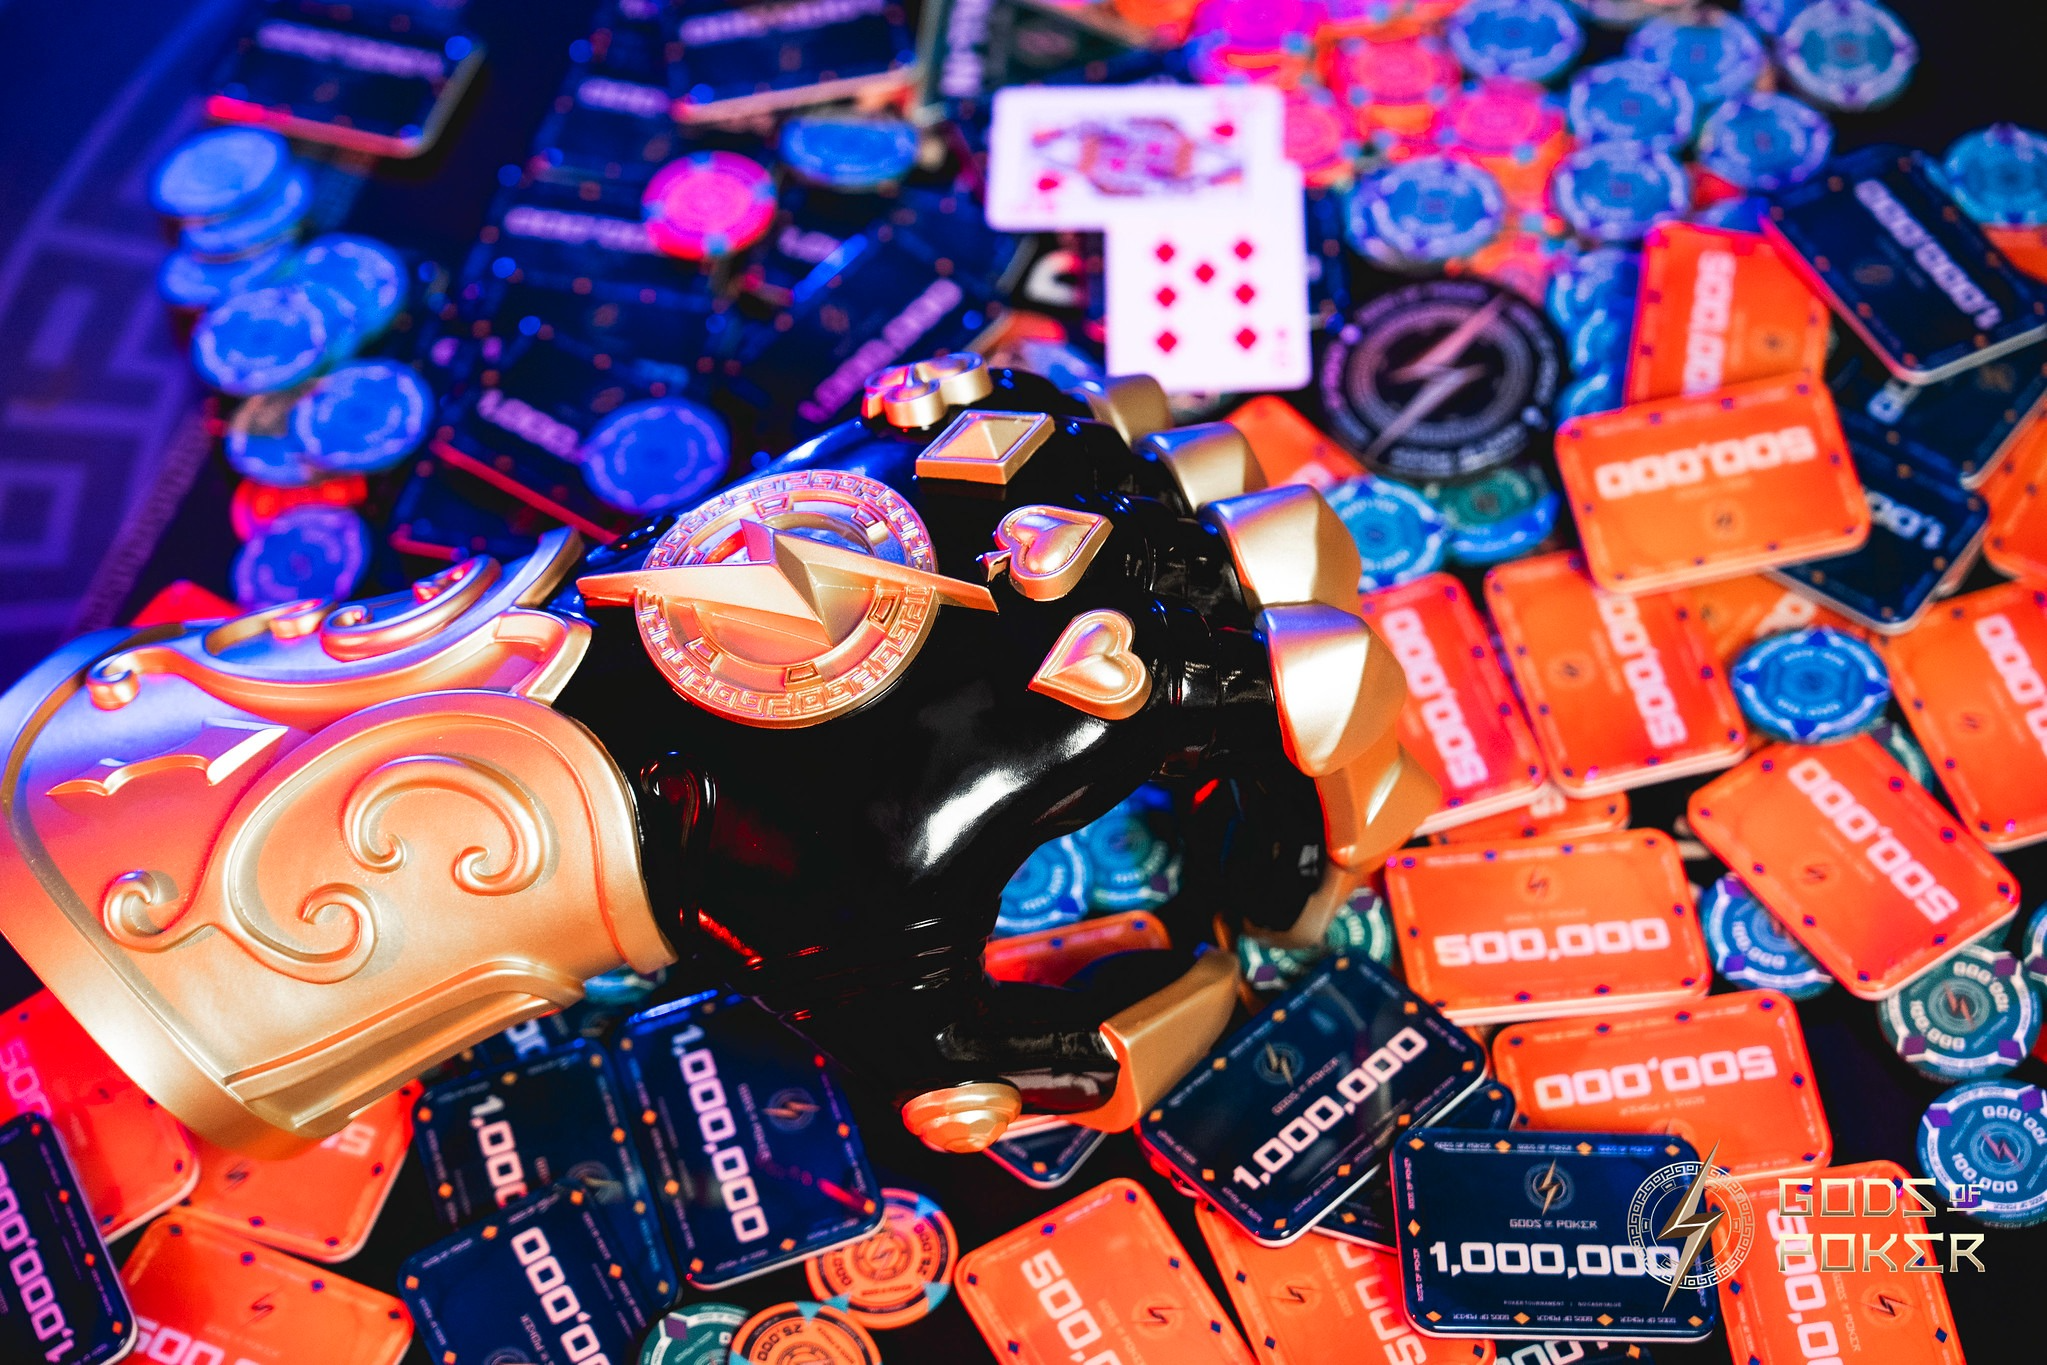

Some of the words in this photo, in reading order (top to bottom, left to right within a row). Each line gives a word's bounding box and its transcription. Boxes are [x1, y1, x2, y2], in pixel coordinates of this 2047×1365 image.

[1595, 425, 1818, 499] 500,000
[1382, 608, 1489, 788] 500,000
[1597, 590, 1688, 748] 500,00
[1787, 757, 1960, 924] 500,000
[1433, 918, 1670, 967] 500,000
[672, 1025, 769, 1243] 1,000,000
[1232, 1026, 1428, 1190] 1,000,000
[1534, 1045, 1777, 1111] 500,000
[1429, 1241, 1681, 1279] 1,000,000
[1510, 1218, 1542, 1229] GODS
[1556, 1219, 1598, 1230] POKER
[1766, 1204, 1843, 1365] 500,0
[1842, 1313, 1862, 1352] POKER
